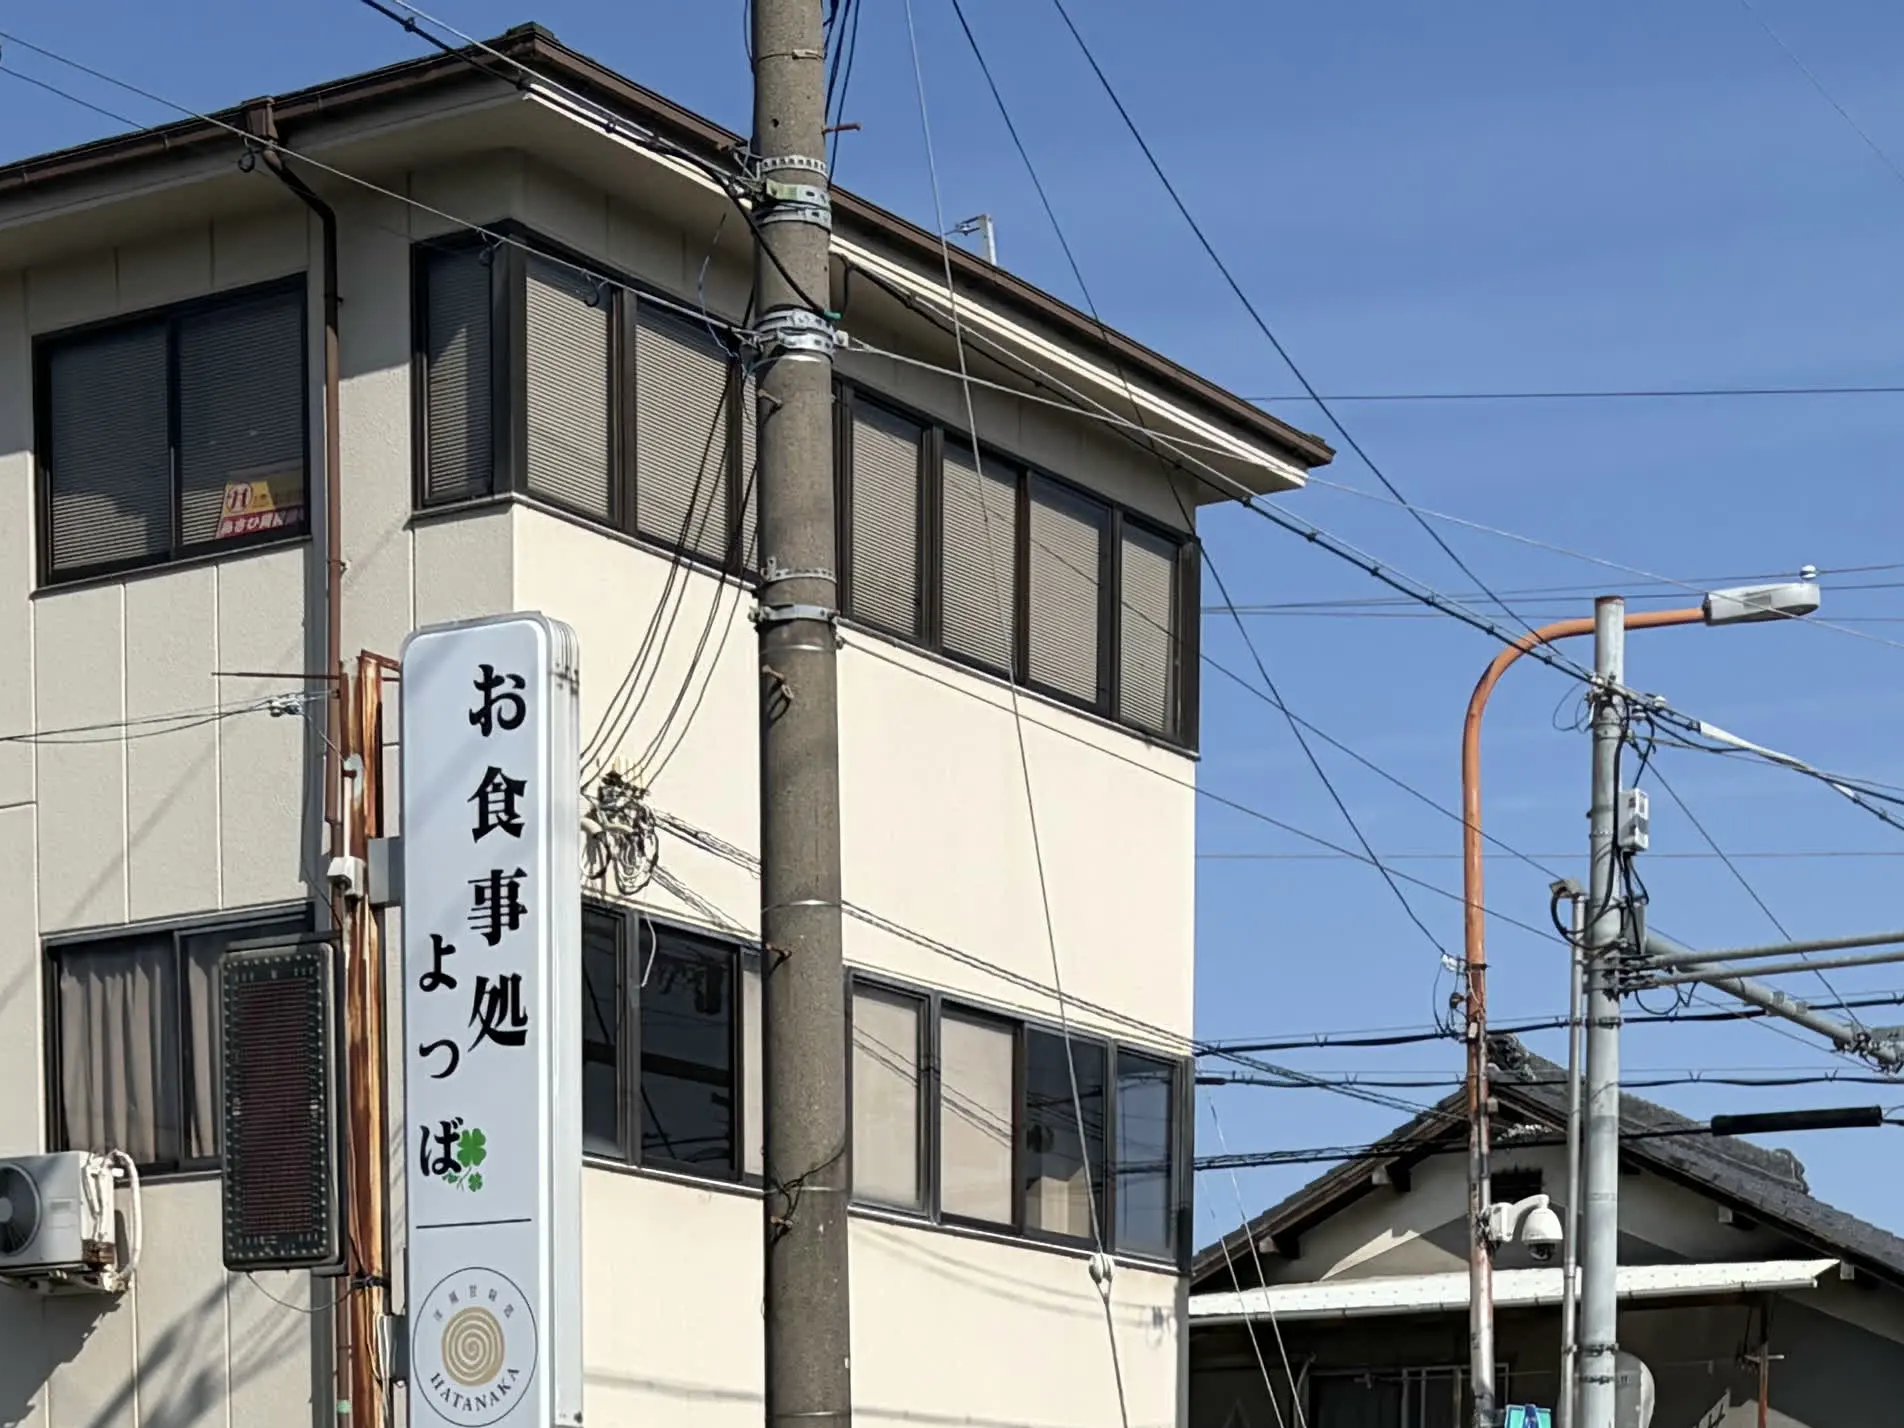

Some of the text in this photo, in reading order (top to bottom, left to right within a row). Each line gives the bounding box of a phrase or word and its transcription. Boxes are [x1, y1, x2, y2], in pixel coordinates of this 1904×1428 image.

[466, 664, 529, 1053] お食事処
[418, 933, 464, 1177] よつば
[430, 1367, 520, 1412] HATANAKA
